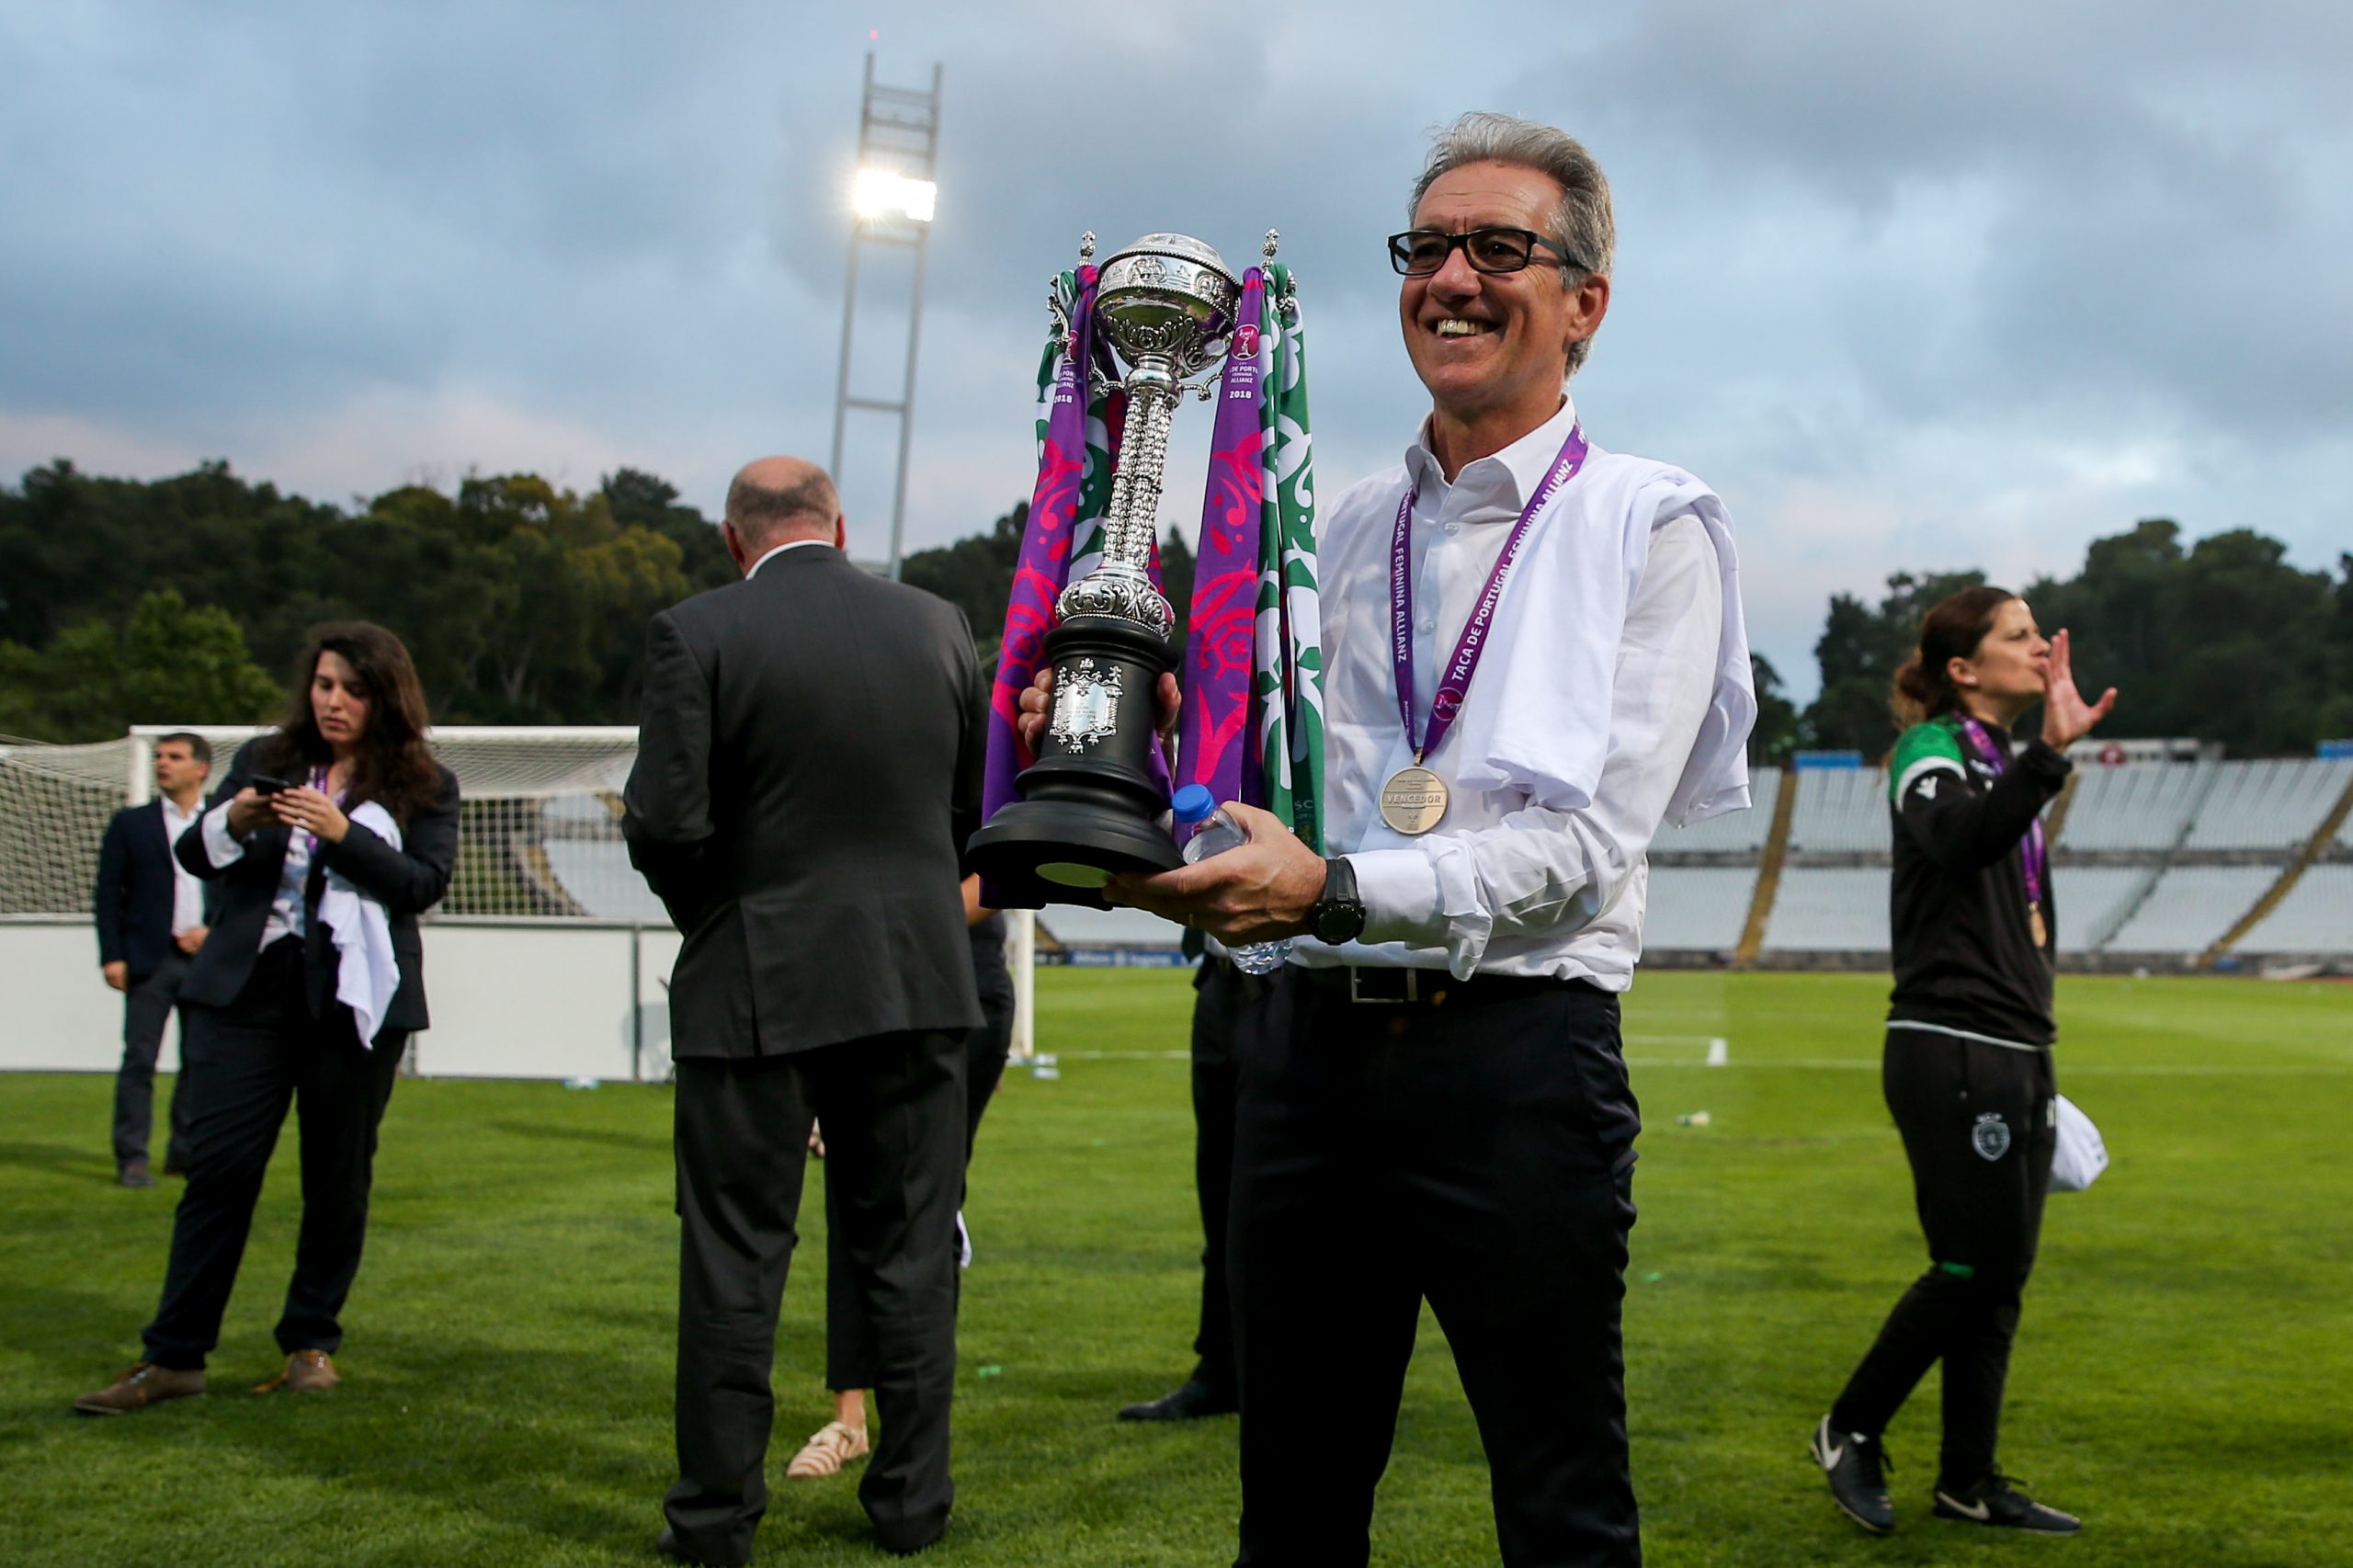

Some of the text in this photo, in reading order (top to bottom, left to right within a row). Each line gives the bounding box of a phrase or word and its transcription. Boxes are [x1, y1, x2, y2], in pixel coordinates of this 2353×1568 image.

[1230, 391, 1251, 399] 2018
[1395, 547, 1405, 608] FEMININA
[1474, 563, 1511, 627] PORTUGAL
[1396, 610, 1407, 664] ALLIANZ
[1467, 627, 1482, 646] DE
[1387, 794, 1441, 803] VENCEDOR
